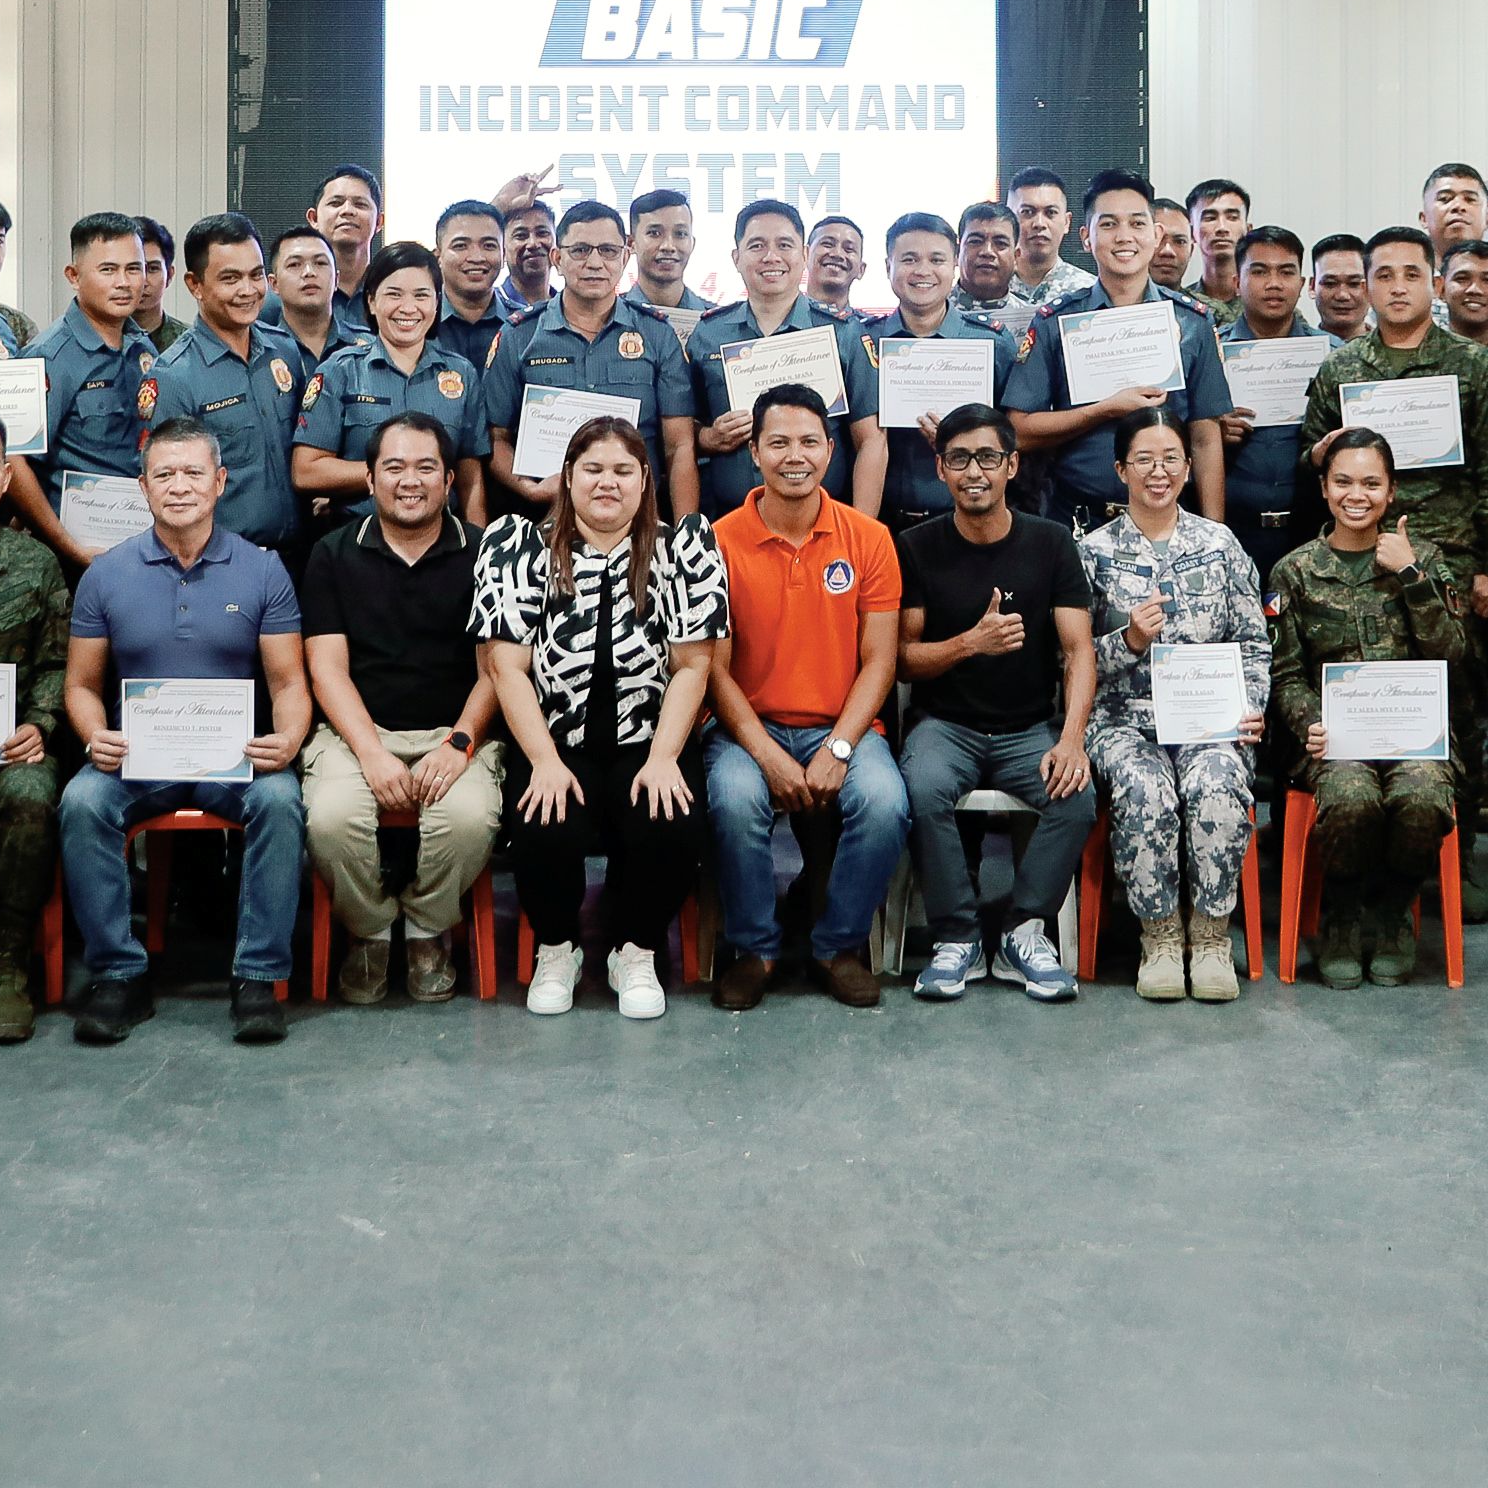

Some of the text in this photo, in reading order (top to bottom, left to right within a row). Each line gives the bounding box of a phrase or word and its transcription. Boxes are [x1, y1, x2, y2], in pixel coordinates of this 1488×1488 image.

[419, 84, 965, 132] INCIDENT COMMAND
[557, 152, 841, 212] SYSTEM
[1070, 336, 1107, 348] Certificate
[1116, 327, 1168, 340] Attendance
[530, 357, 568, 366] BRUGADA
[732, 364, 769, 375] Certificate
[778, 352, 831, 367] Attendance
[888, 360, 923, 372] Certificate
[933, 359, 984, 372] Attendance
[206, 397, 240, 411] MOJICA
[530, 407, 566, 423] Certificate
[71, 494, 107, 508] Certificate
[108, 502, 117, 512] of
[1174, 558, 1200, 572] COAST
[1331, 686, 1370, 700] Certificate
[1380, 683, 1438, 697] Attendance
[131, 702, 173, 718] Certificate
[184, 701, 245, 716] Attendance
